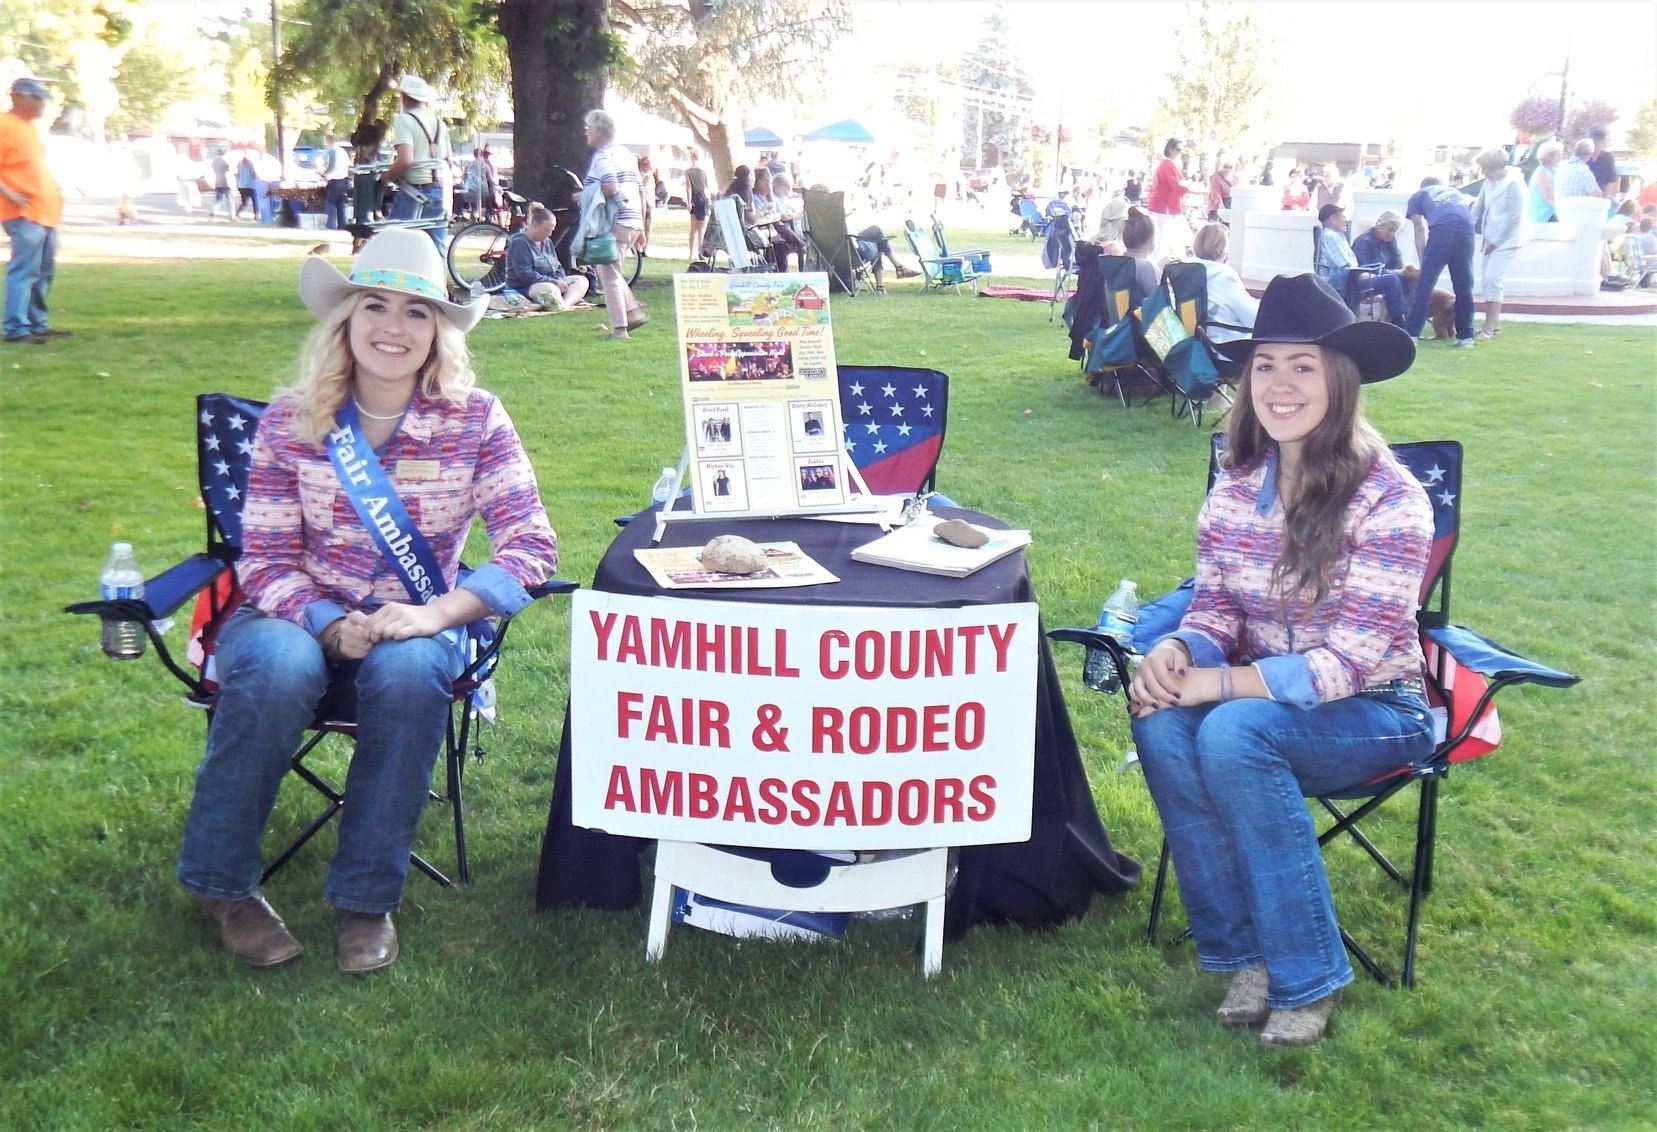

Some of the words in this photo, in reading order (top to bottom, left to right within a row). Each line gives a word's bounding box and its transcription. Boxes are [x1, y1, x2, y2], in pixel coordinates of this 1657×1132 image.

[731, 326, 774, 341] Squealing
[777, 326, 800, 338] Good
[801, 325, 825, 337] Time!
[330, 424, 372, 487] Fair
[588, 610, 800, 678] YAMHILL
[818, 622, 1019, 680] COUNTY
[616, 690, 732, 749] FAIR
[751, 703, 790, 752] &
[811, 701, 987, 754] RODEO
[603, 764, 998, 827] AMBASSADORS
